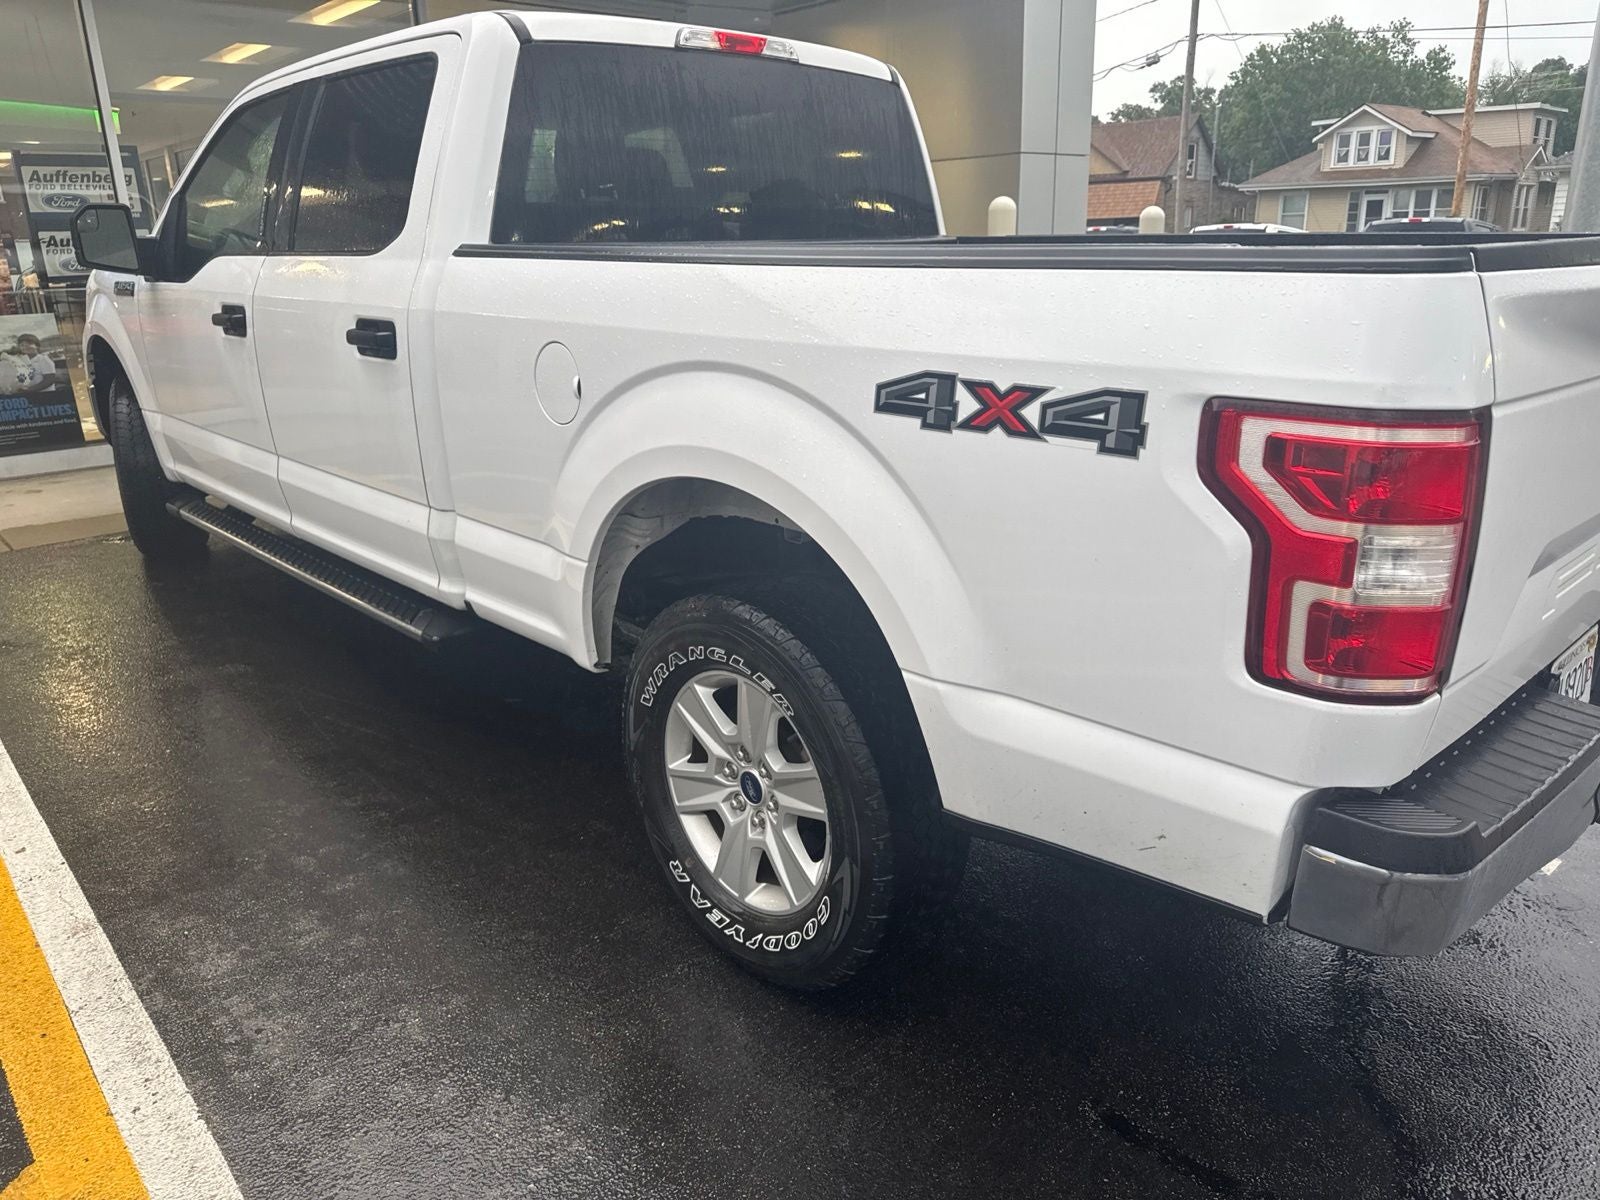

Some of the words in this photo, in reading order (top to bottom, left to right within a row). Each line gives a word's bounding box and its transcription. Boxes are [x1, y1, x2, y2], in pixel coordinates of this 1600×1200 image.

[28, 169, 133, 186] Auffenbeg
[28, 183, 56, 191] FORD
[60, 183, 113, 191] BELLEVILL
[51, 195, 81, 207] Ford
[40, 403, 76, 418] LIVES.
[640, 646, 794, 716] WRANGLER
[669, 860, 830, 951] GOODYEAR
